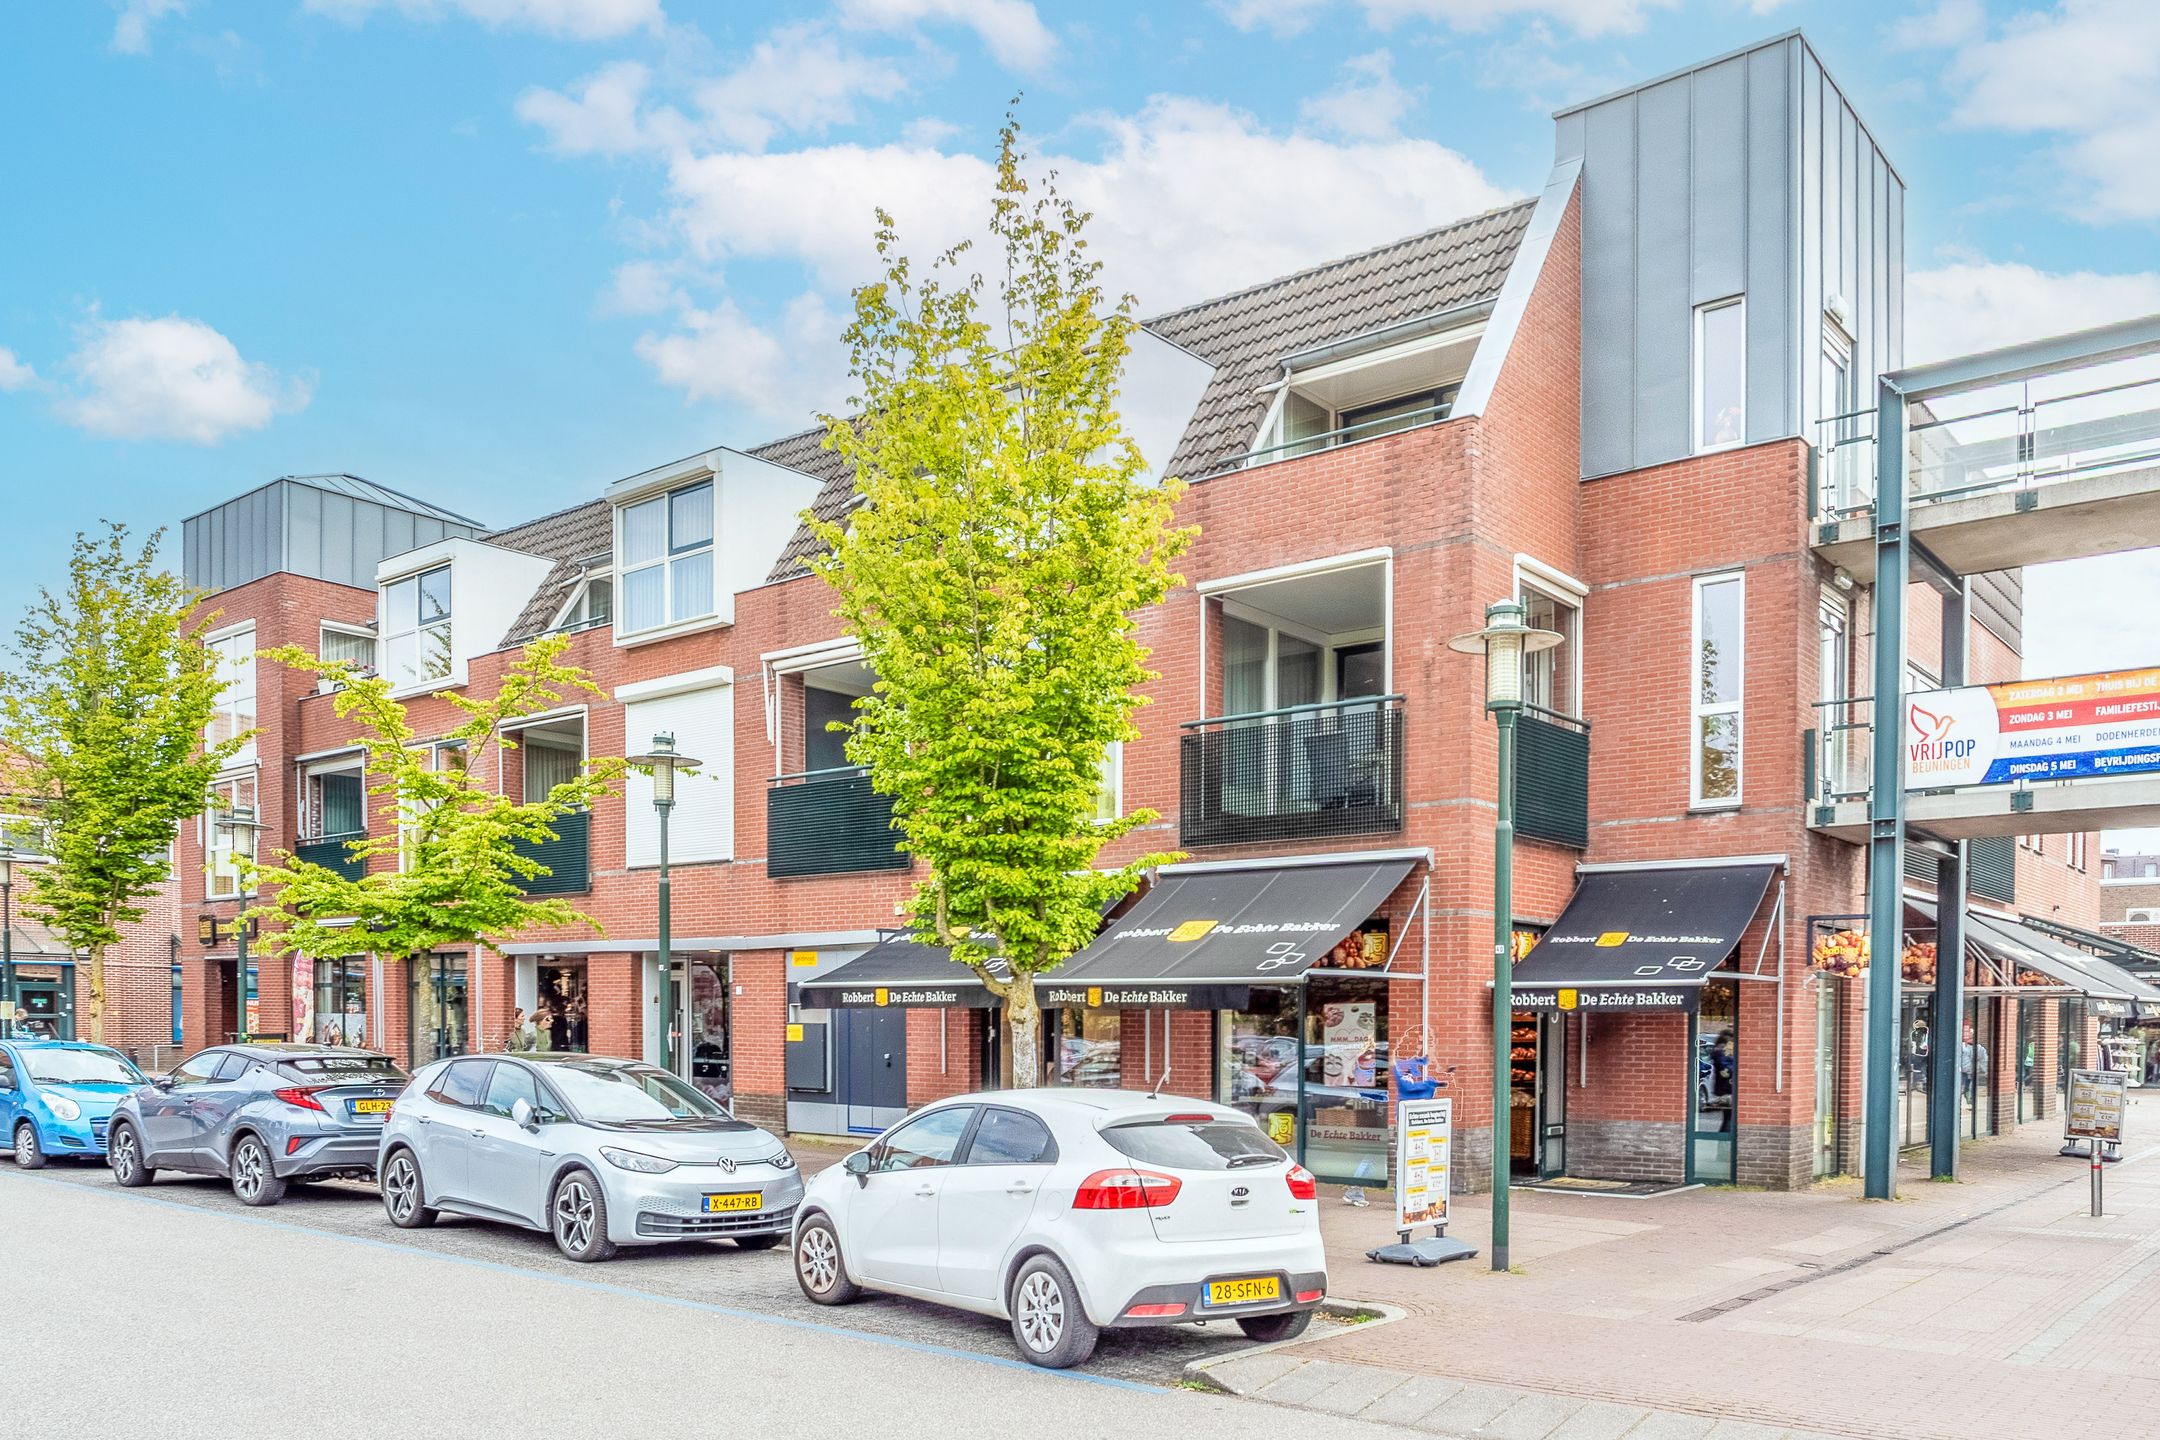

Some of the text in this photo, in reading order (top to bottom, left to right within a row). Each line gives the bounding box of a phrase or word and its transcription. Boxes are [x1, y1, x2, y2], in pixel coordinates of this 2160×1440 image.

[2126, 679, 2142, 689] BIJ
[2144, 676, 2157, 686] DE
[2066, 685, 2083, 695] MEI
[2009, 709, 2073, 724] ZONDAG 3 MEI
[2096, 727, 2160, 742] DODENHERDE
[2010, 735, 2081, 749] MAANDAG 4 MEI
[1910, 739, 1976, 761] VRIJPOP
[1912, 758, 1971, 774] BEUNINGEN
[2010, 759, 2077, 774] DINSDAG 5 MEI
[1113, 922, 1341, 940] Robbert De Echte Bakker
[1550, 935, 1724, 944] Robbert De Echte Bakker
[842, 990, 957, 1003] Robbert De Echte Bakker
[1049, 989, 1188, 1003] Robbert De Echte Bakker
[1510, 992, 1684, 1006] Robbert De Echte Bakker
[359, 1102, 391, 1111] GLH-23
[1310, 1129, 1382, 1142] De Echte Bakker
[1232, 1187, 1249, 1196] KIA
[713, 1197, 758, 1210] X-447-RB
[1215, 1281, 1274, 1300] 28-SFN-6
